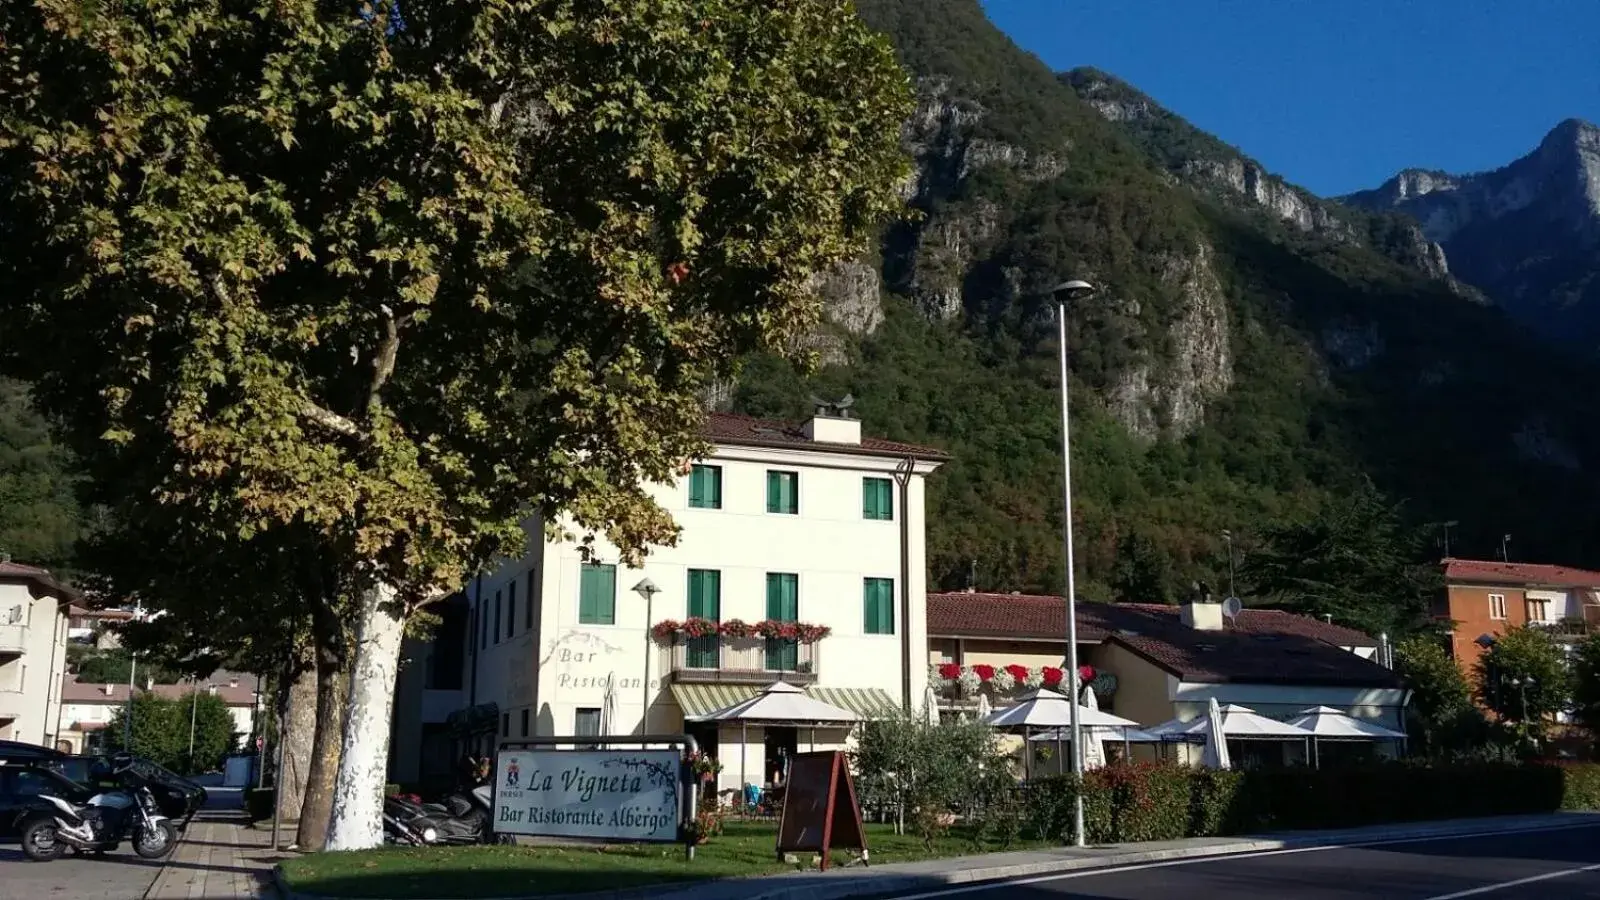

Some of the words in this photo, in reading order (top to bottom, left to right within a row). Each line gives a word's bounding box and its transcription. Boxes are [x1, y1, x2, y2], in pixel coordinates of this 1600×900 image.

[558, 648, 597, 663] Bar
[558, 673, 658, 689] Ristoane
[526, 770, 553, 792] La
[561, 766, 642, 802] Vigneta
[500, 806, 524, 823] Bar
[528, 806, 604, 826] Ristorante
[608, 807, 669, 835] Albergo
